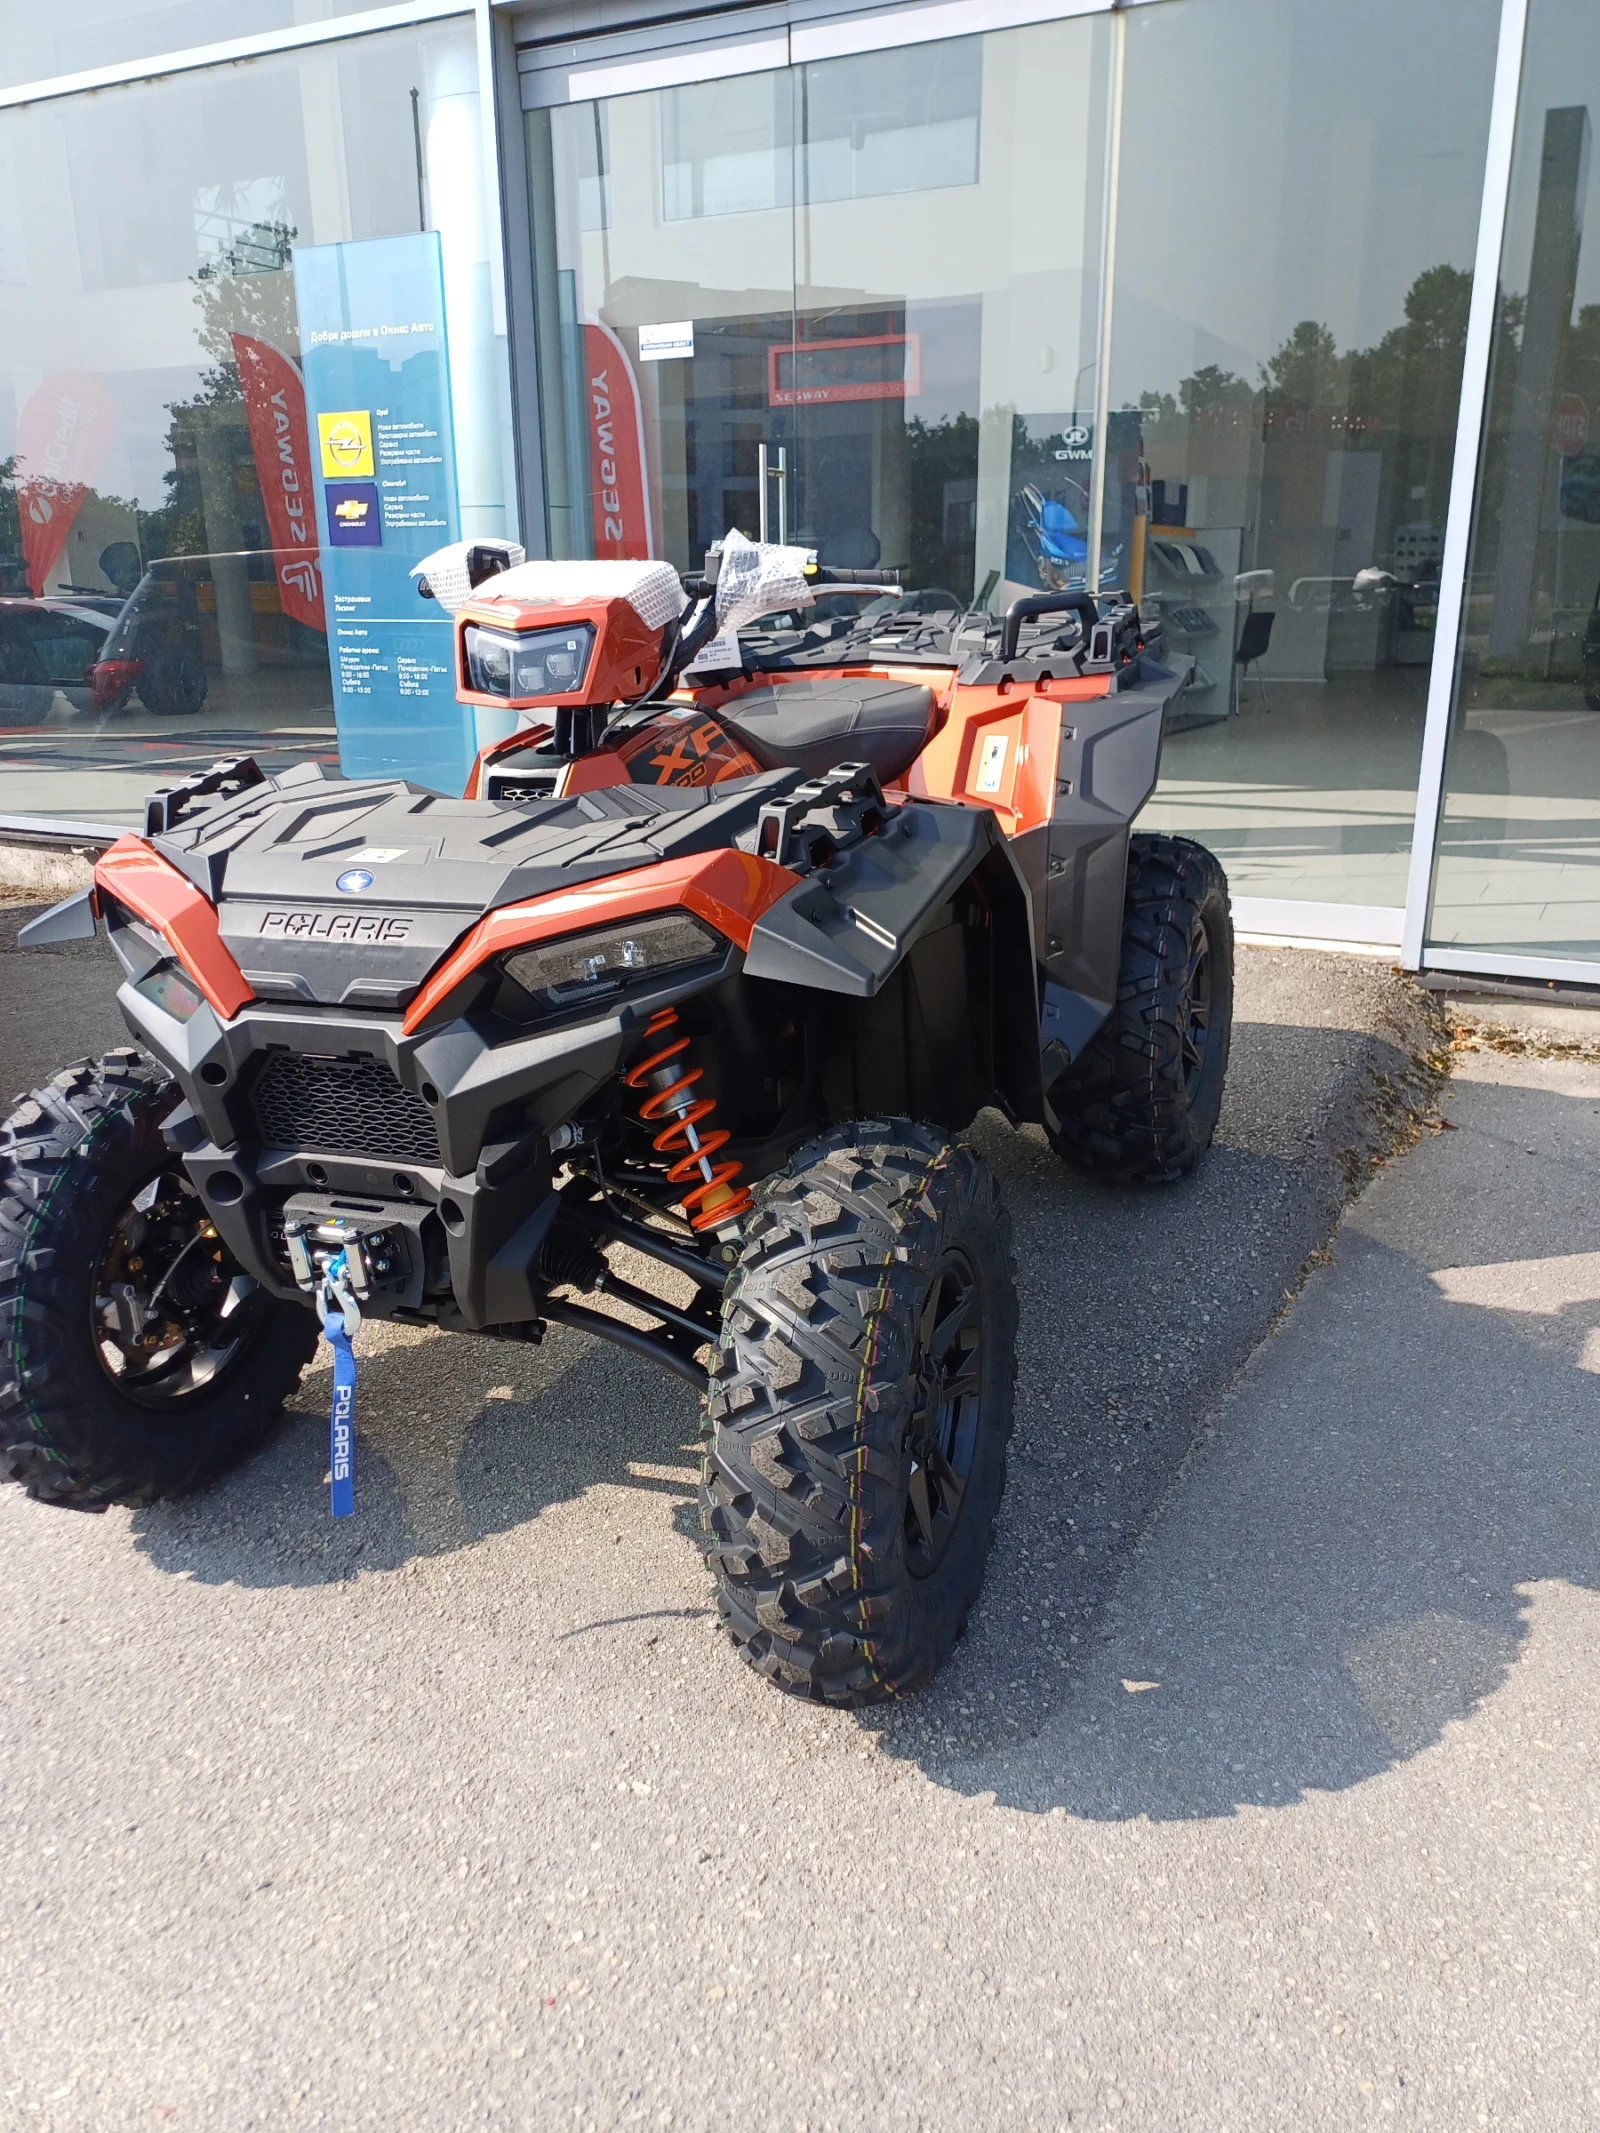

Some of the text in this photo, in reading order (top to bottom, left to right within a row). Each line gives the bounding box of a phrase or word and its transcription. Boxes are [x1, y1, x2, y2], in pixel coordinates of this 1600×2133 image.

[310, 322, 434, 344] Добре дошли в Оникс Авто
[775, 390, 829, 402] SEGWAY
[35, 396, 82, 498] UniCredit
[1055, 449, 1093, 460] GWM
[649, 720, 724, 787] XP
[654, 723, 694, 753] SPORTSMAN
[259, 911, 414, 944] POLARIS
[334, 1385, 352, 1481] POLARIS
